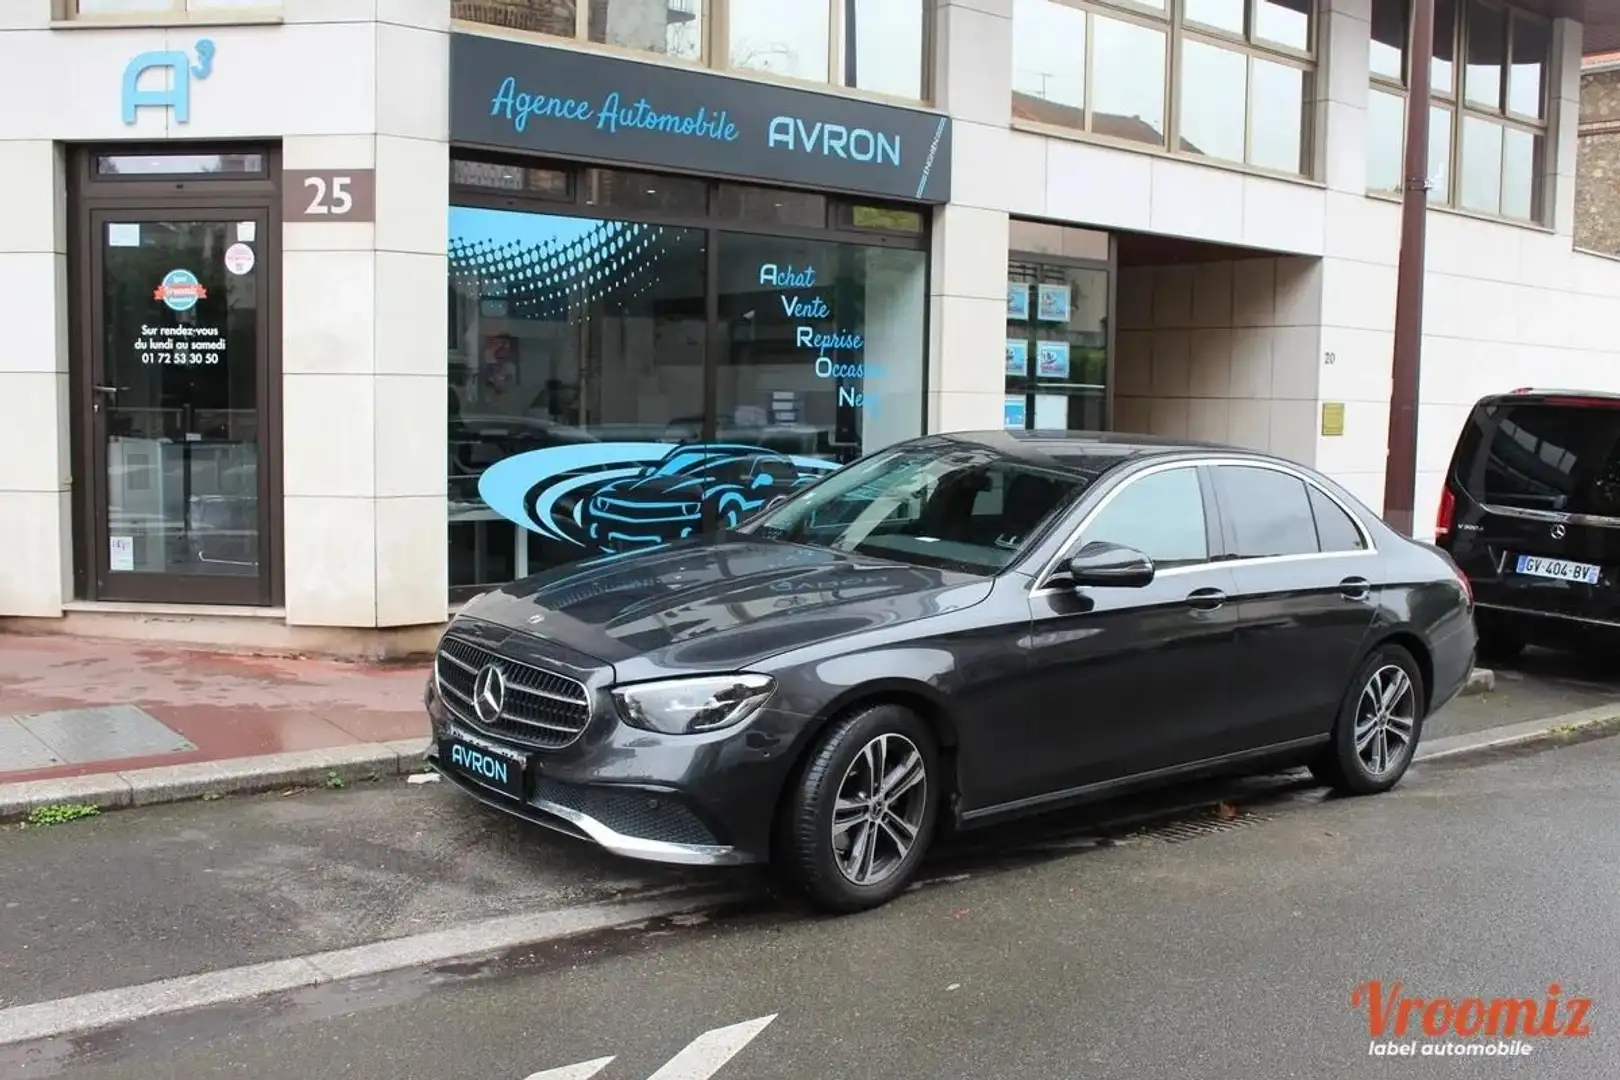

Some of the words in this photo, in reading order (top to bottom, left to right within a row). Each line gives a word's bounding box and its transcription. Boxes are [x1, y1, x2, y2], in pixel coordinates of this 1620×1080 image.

[491, 76, 593, 132] Agence
[596, 91, 740, 142] Automobile
[767, 115, 901, 166] AVRON
[303, 176, 353, 215] 25
[759, 263, 815, 288] Achat
[781, 295, 830, 318] Vente
[141, 324, 158, 335] Sur
[160, 324, 218, 336] rendez-vous
[796, 326, 864, 356] Reprise
[134, 338, 147, 350] du
[149, 338, 173, 350] lundi
[175, 341, 189, 350] au
[191, 338, 226, 350] samedi
[141, 353, 155, 364] 01
[157, 353, 172, 364] 72
[173, 353, 187, 364] 53
[189, 353, 203, 364] 30
[205, 353, 219, 364] 50
[815, 357, 882, 378] Occas
[1526, 558, 1590, 579] GV-404-BV
[451, 744, 508, 784] AVRON
